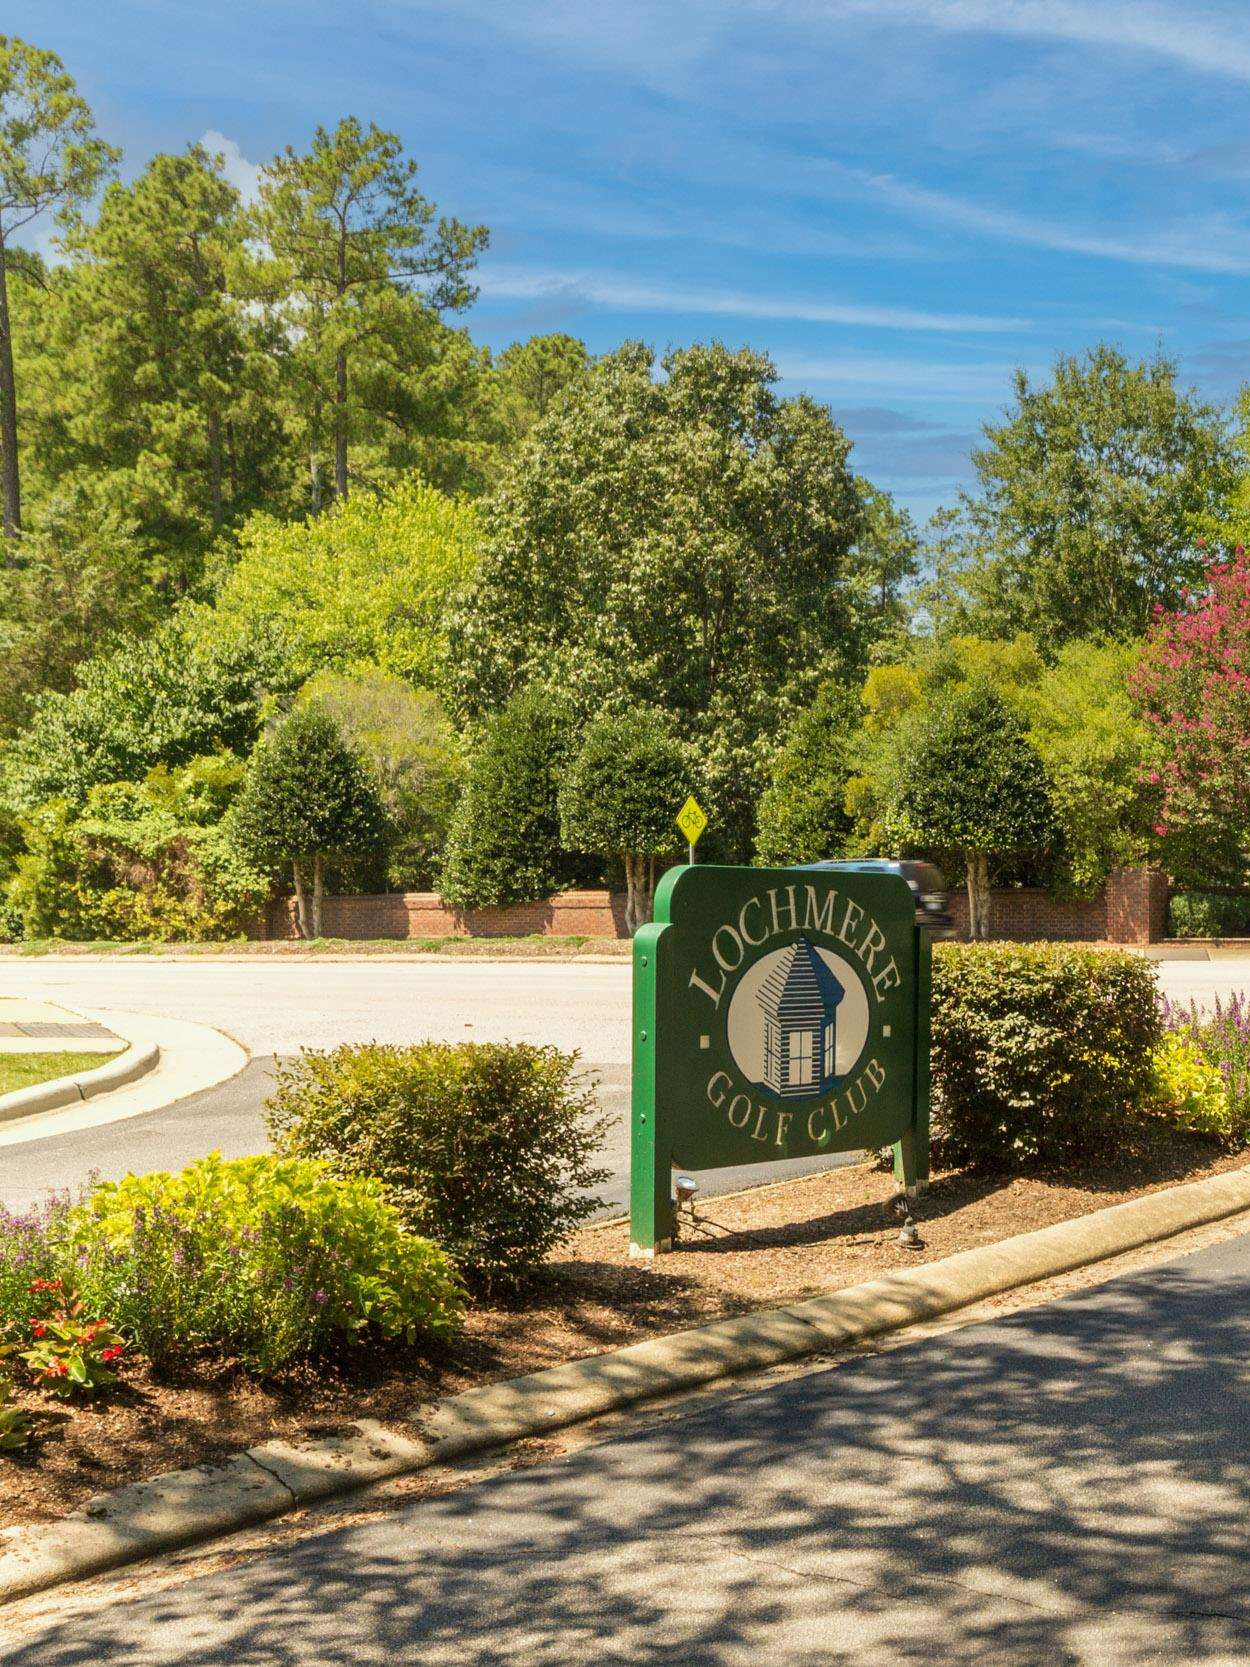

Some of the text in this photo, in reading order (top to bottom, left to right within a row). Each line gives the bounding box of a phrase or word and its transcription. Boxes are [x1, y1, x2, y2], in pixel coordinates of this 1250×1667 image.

[688, 884, 901, 1010] LOCHMERE
[706, 1057, 886, 1146] GOLF CLUB
